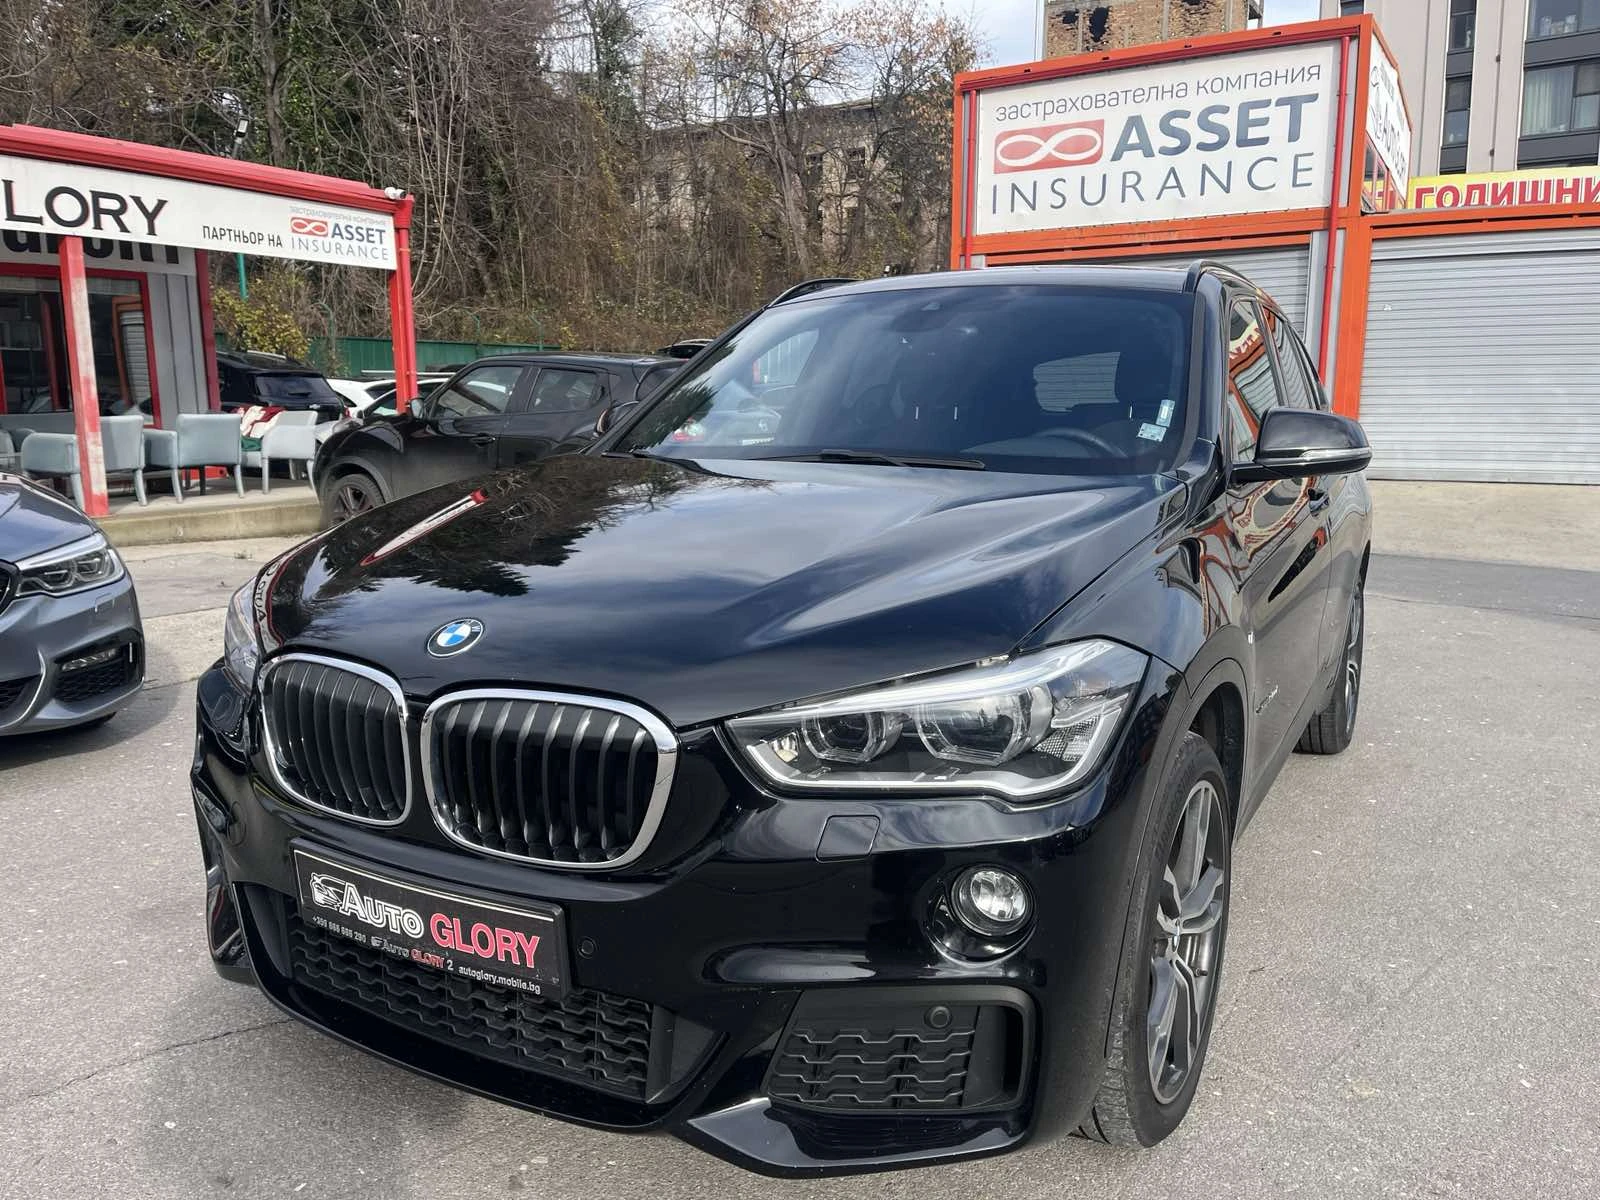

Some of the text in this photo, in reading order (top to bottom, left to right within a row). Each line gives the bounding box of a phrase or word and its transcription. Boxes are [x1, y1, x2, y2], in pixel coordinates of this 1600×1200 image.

[995, 64, 1321, 122] застрахователна компания
[1110, 93, 1319, 162] ASSET
[2, 179, 168, 236] LORY
[992, 152, 1314, 214] INSURANCE
[202, 225, 283, 248] ПАРТНЬОР НА
[291, 236, 389, 261] INSURANCE
[331, 223, 386, 244] ASSET
[430, 912, 540, 969] GLORY
[446, 959, 454, 971] 2
[458, 965, 541, 995] autoglory.mobile.bg
